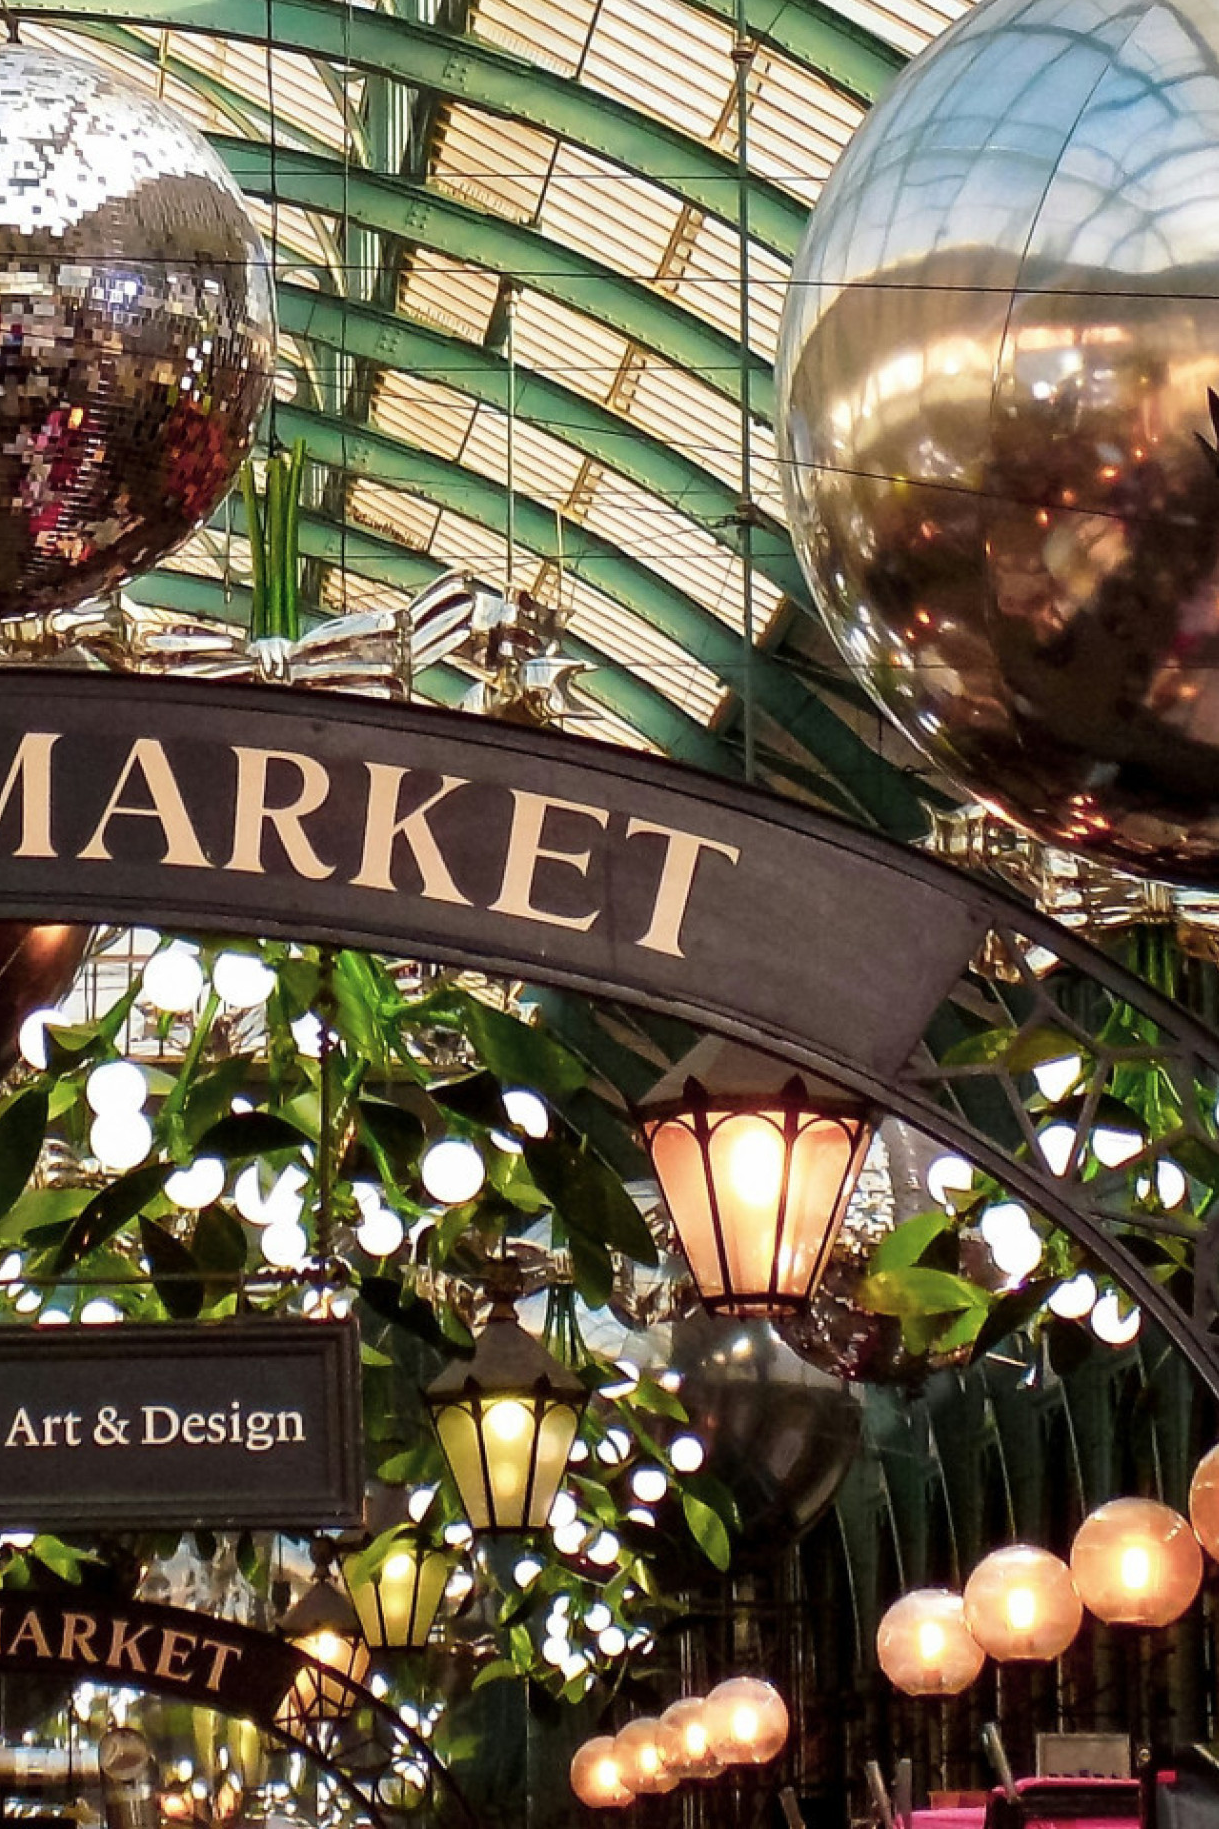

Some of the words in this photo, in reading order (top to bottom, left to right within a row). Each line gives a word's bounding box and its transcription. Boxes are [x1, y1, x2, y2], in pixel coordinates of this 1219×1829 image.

[4, 1408, 82, 1447] Art
[93, 1406, 130, 1445] &
[141, 1401, 306, 1451] Design
